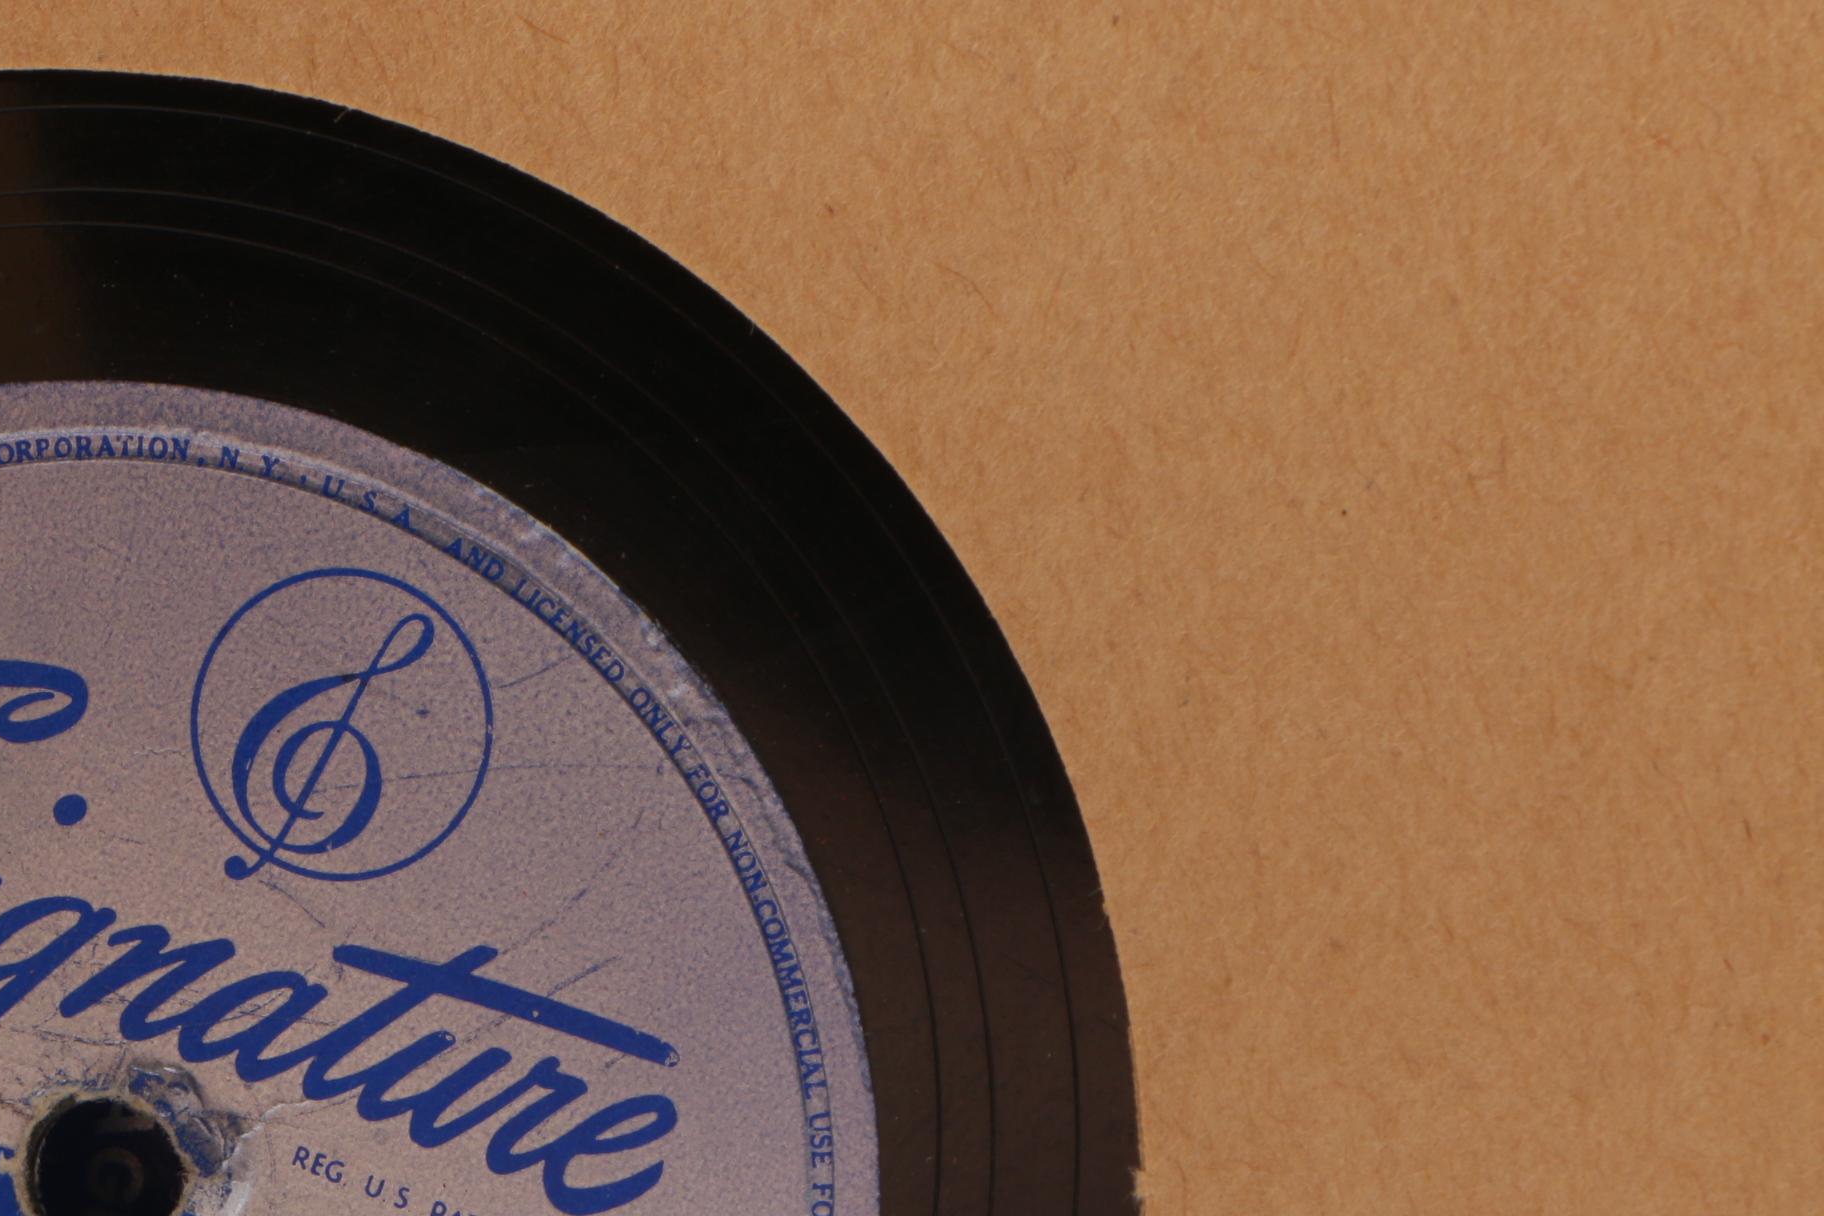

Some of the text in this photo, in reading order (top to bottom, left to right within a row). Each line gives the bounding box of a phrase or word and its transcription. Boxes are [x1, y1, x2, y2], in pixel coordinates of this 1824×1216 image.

[443, 536, 505, 582] AND
[509, 576, 625, 686] LICENSED
[629, 686, 693, 756] ONLY
[686, 762, 730, 825] FOR
[807, 1111, 835, 1167] USE
